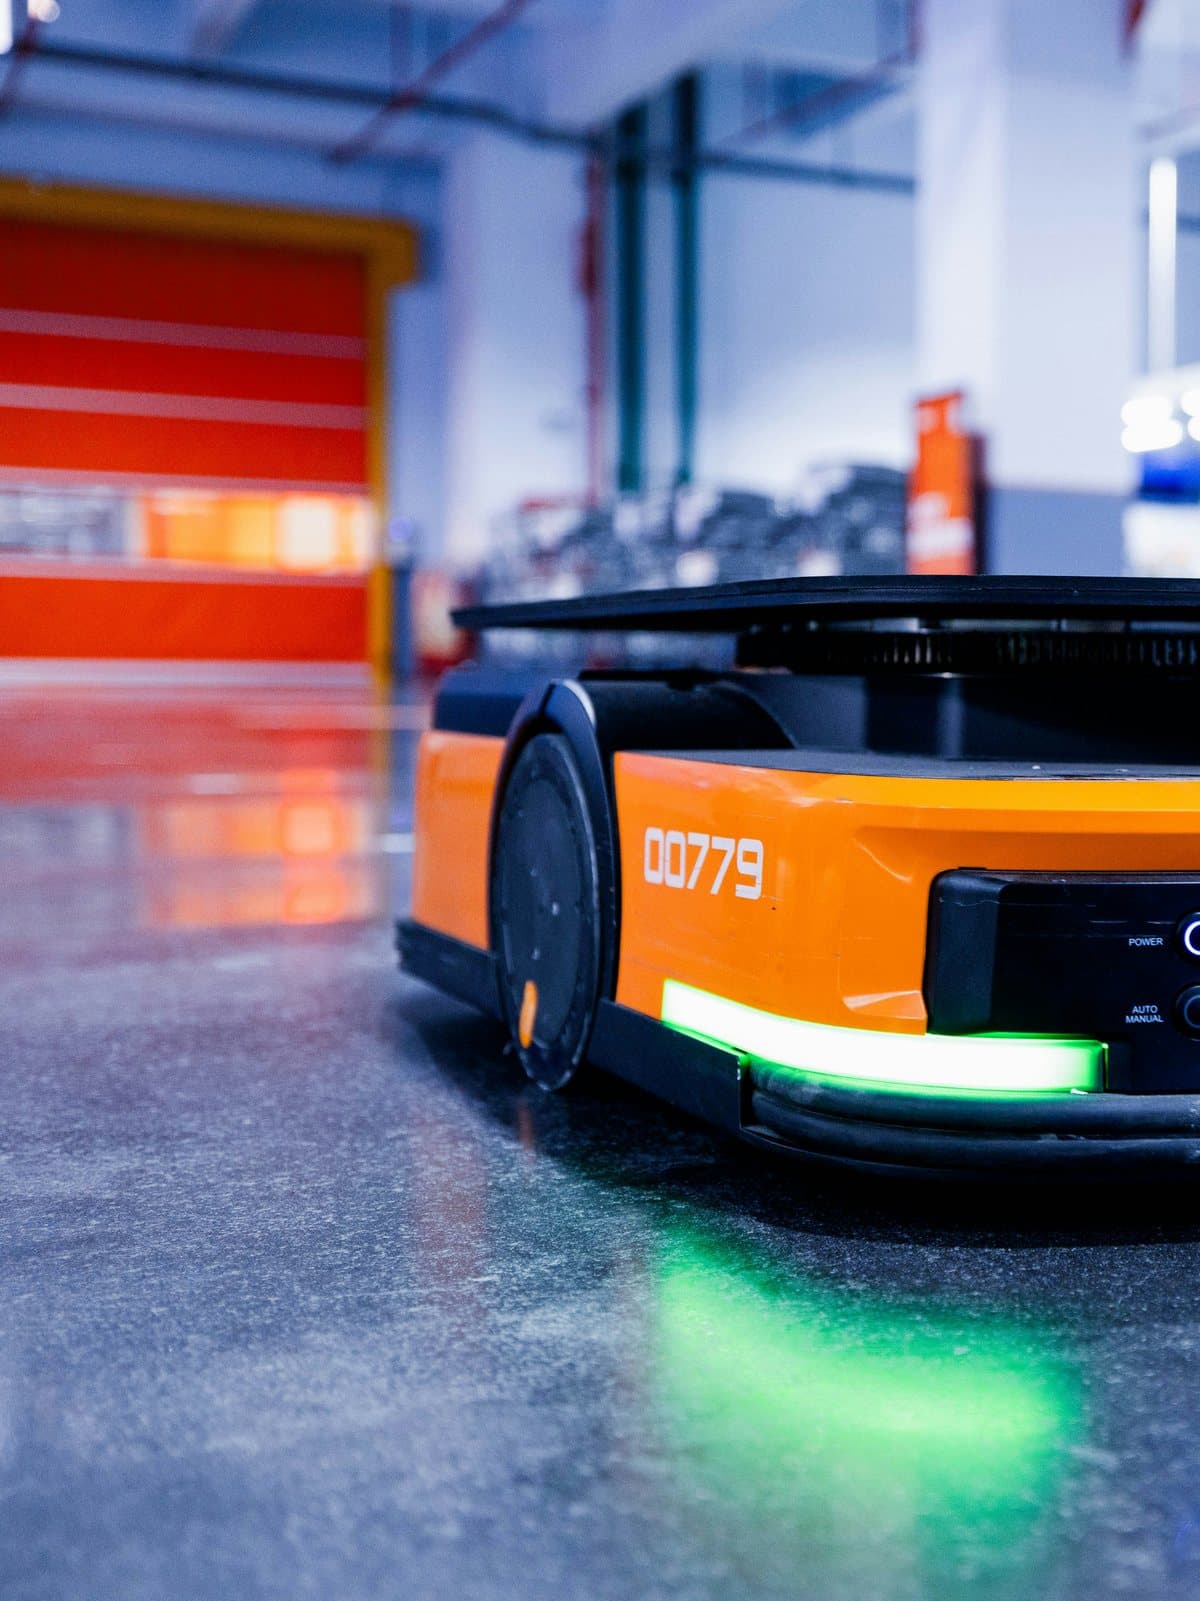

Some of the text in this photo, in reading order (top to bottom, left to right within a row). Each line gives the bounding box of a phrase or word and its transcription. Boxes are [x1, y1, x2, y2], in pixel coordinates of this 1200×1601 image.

[644, 827, 764, 900] 00779
[1128, 937, 1164, 947] POWER
[1132, 1005, 1158, 1014] AUTO
[1125, 1014, 1164, 1024] MANUAL
